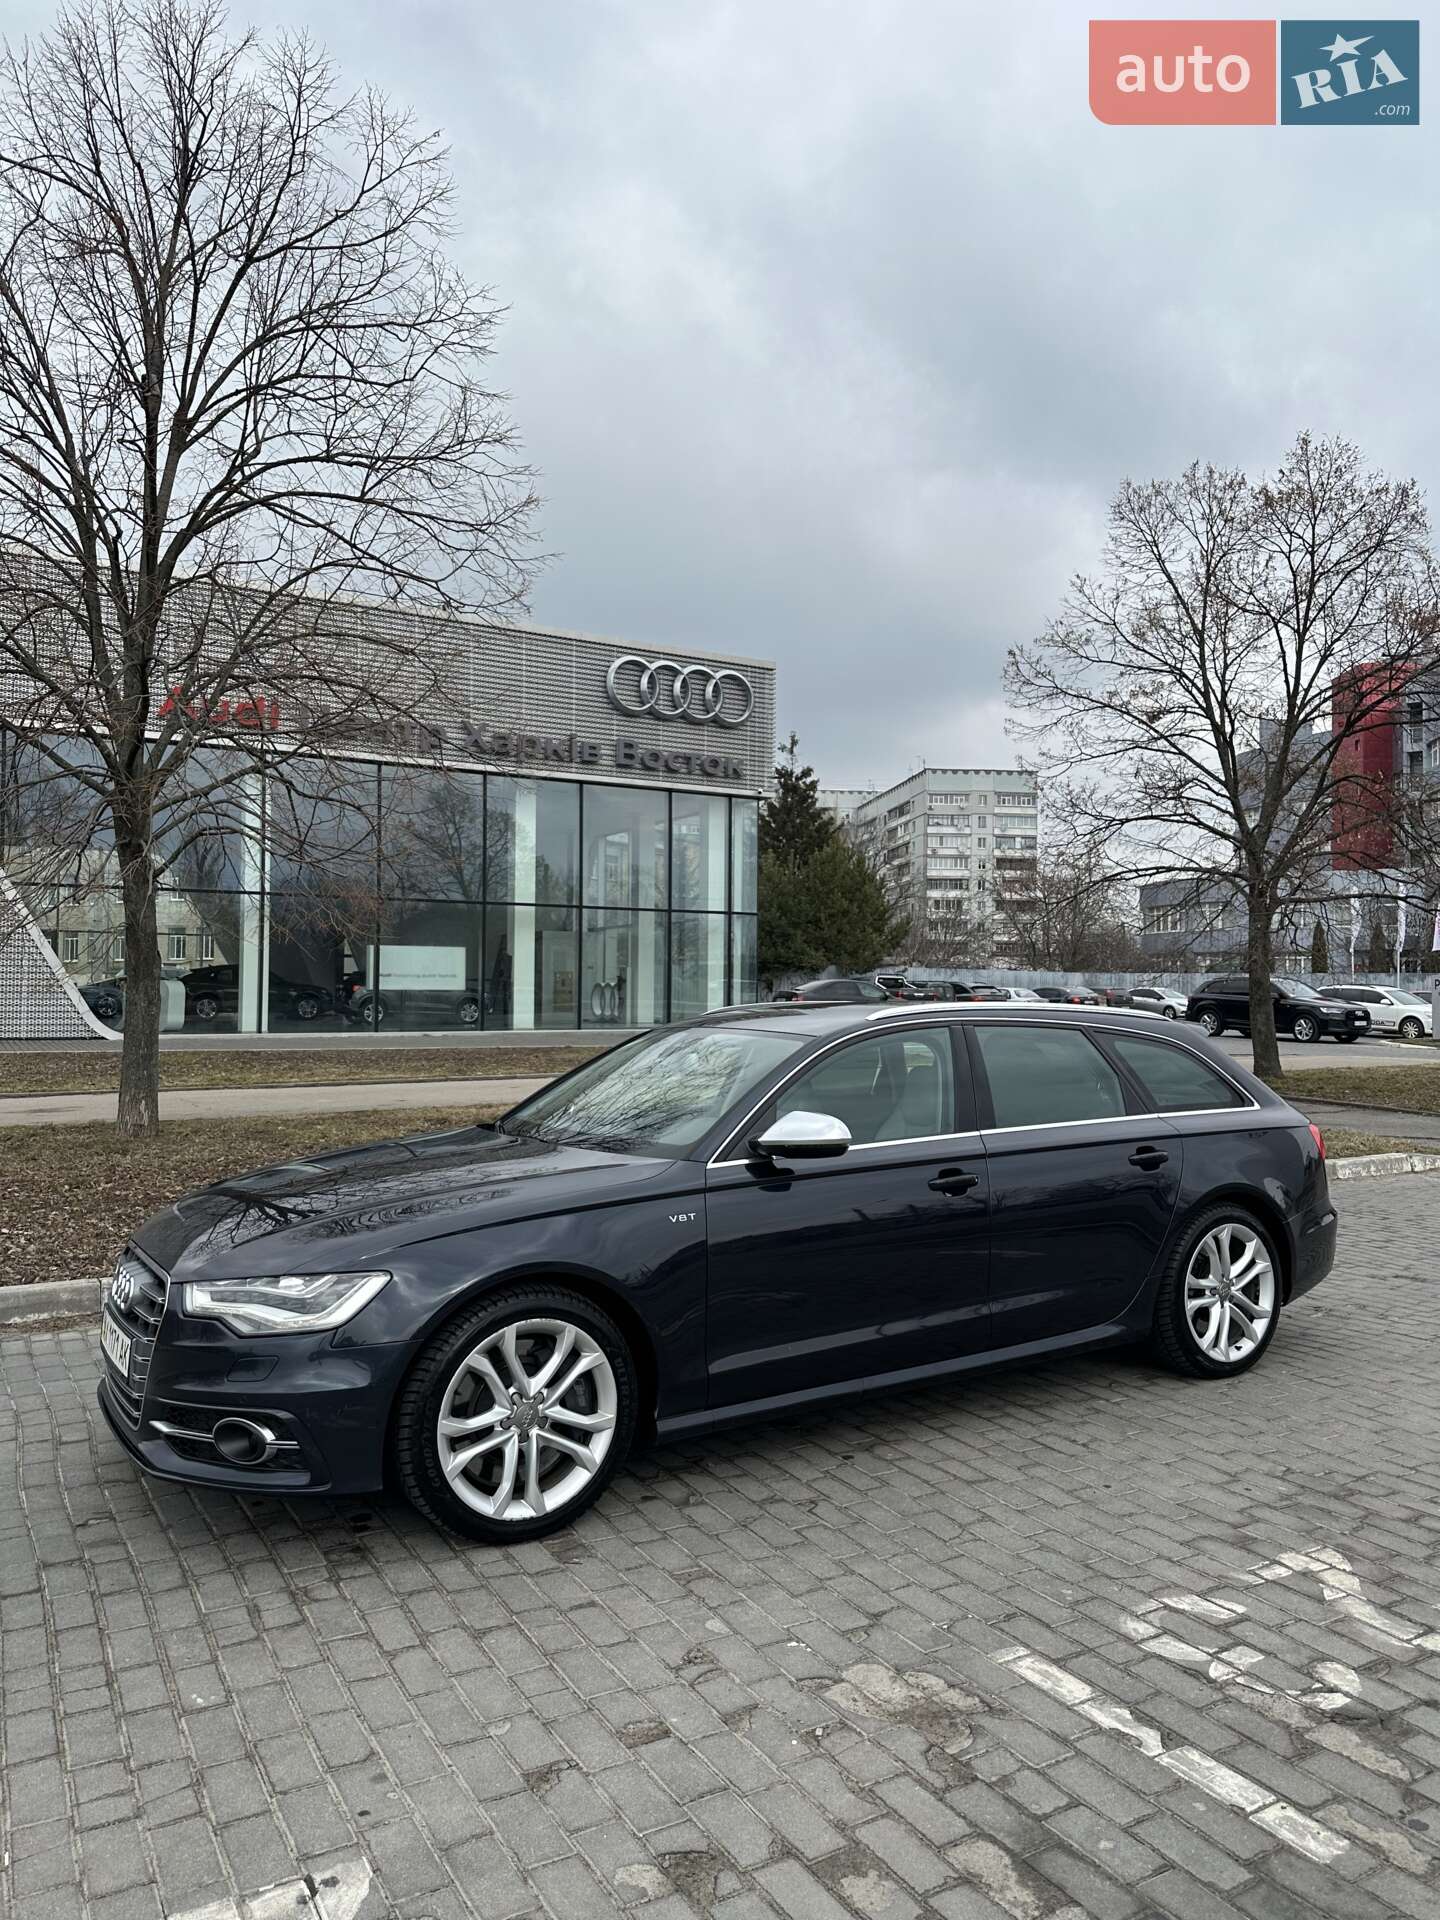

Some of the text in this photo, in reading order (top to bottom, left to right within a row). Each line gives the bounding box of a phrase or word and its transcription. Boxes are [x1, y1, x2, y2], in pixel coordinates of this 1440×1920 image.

[158, 686, 280, 729] Audi
[461, 719, 600, 764] Харків
[616, 737, 745, 777] Восток
[668, 1212, 697, 1223] V8T
